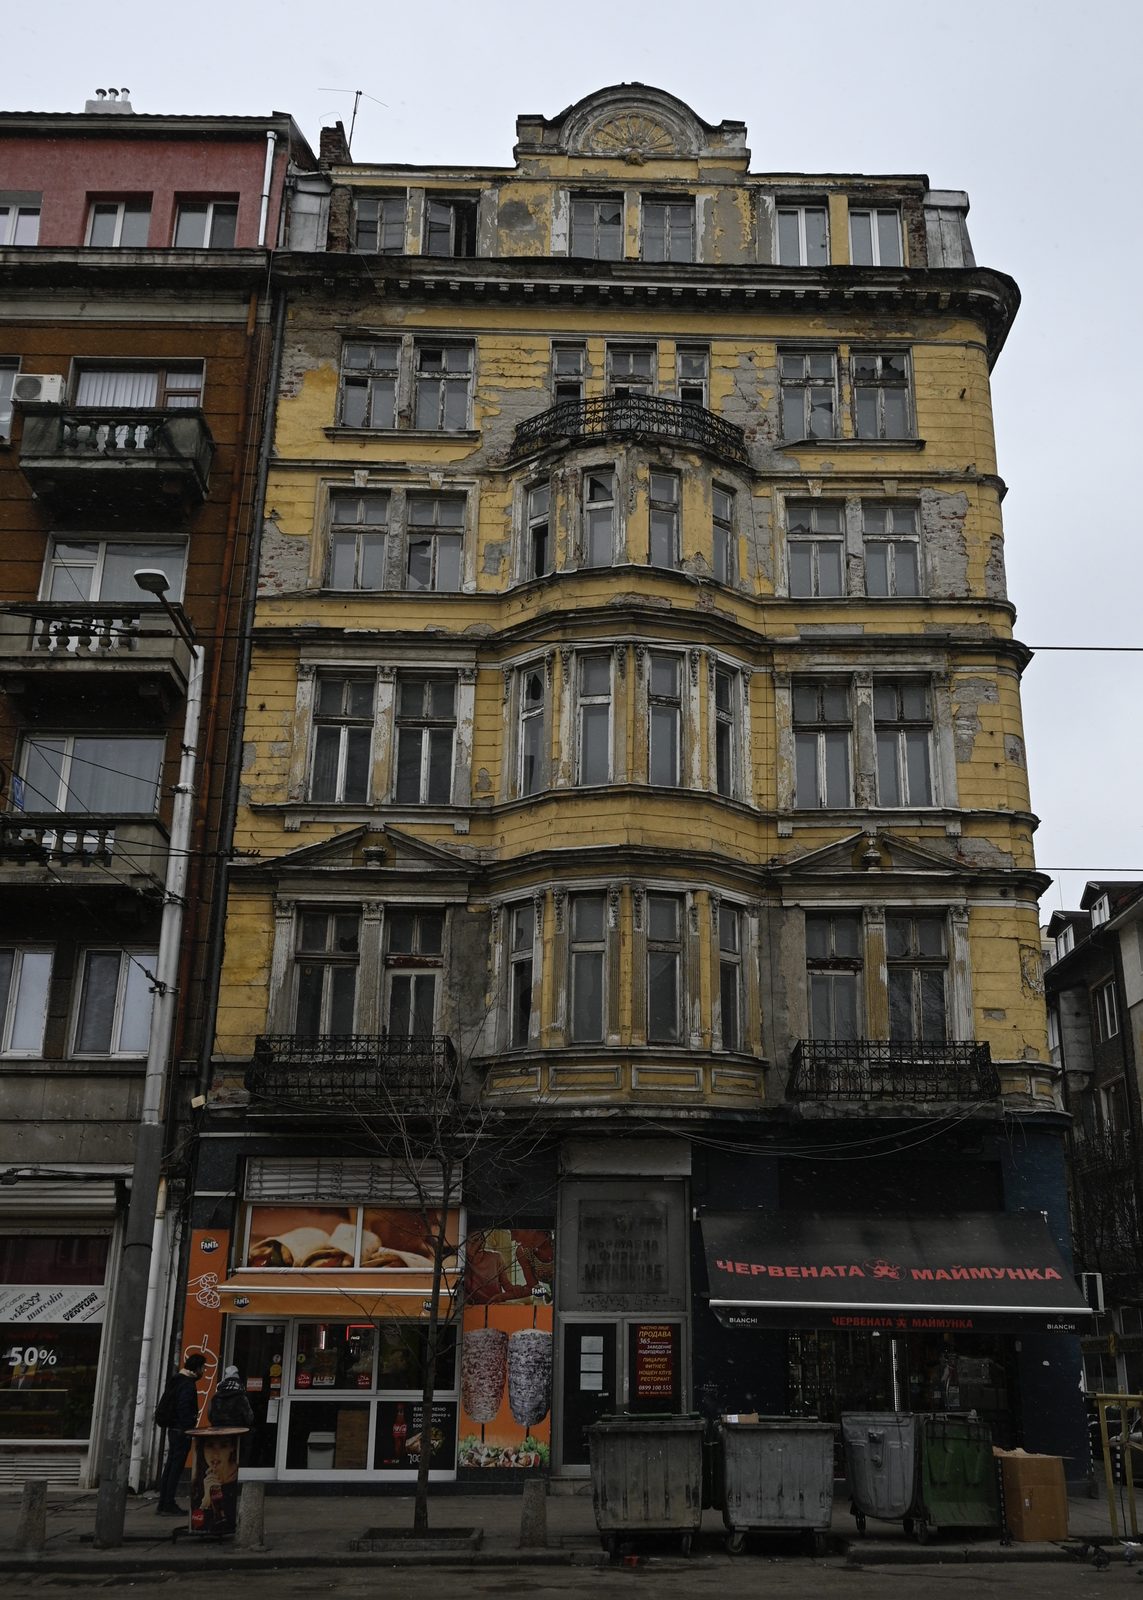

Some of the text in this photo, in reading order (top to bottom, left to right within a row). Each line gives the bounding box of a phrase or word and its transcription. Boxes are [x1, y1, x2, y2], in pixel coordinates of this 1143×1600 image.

[716, 1260, 1063, 1281] ЧЕРВЕНАТА МАЙМУНКА
[64, 1295, 98, 1321] VENTURI
[832, 1316, 974, 1329] ЧЕРВЕНАТА МАЙМУНКА
